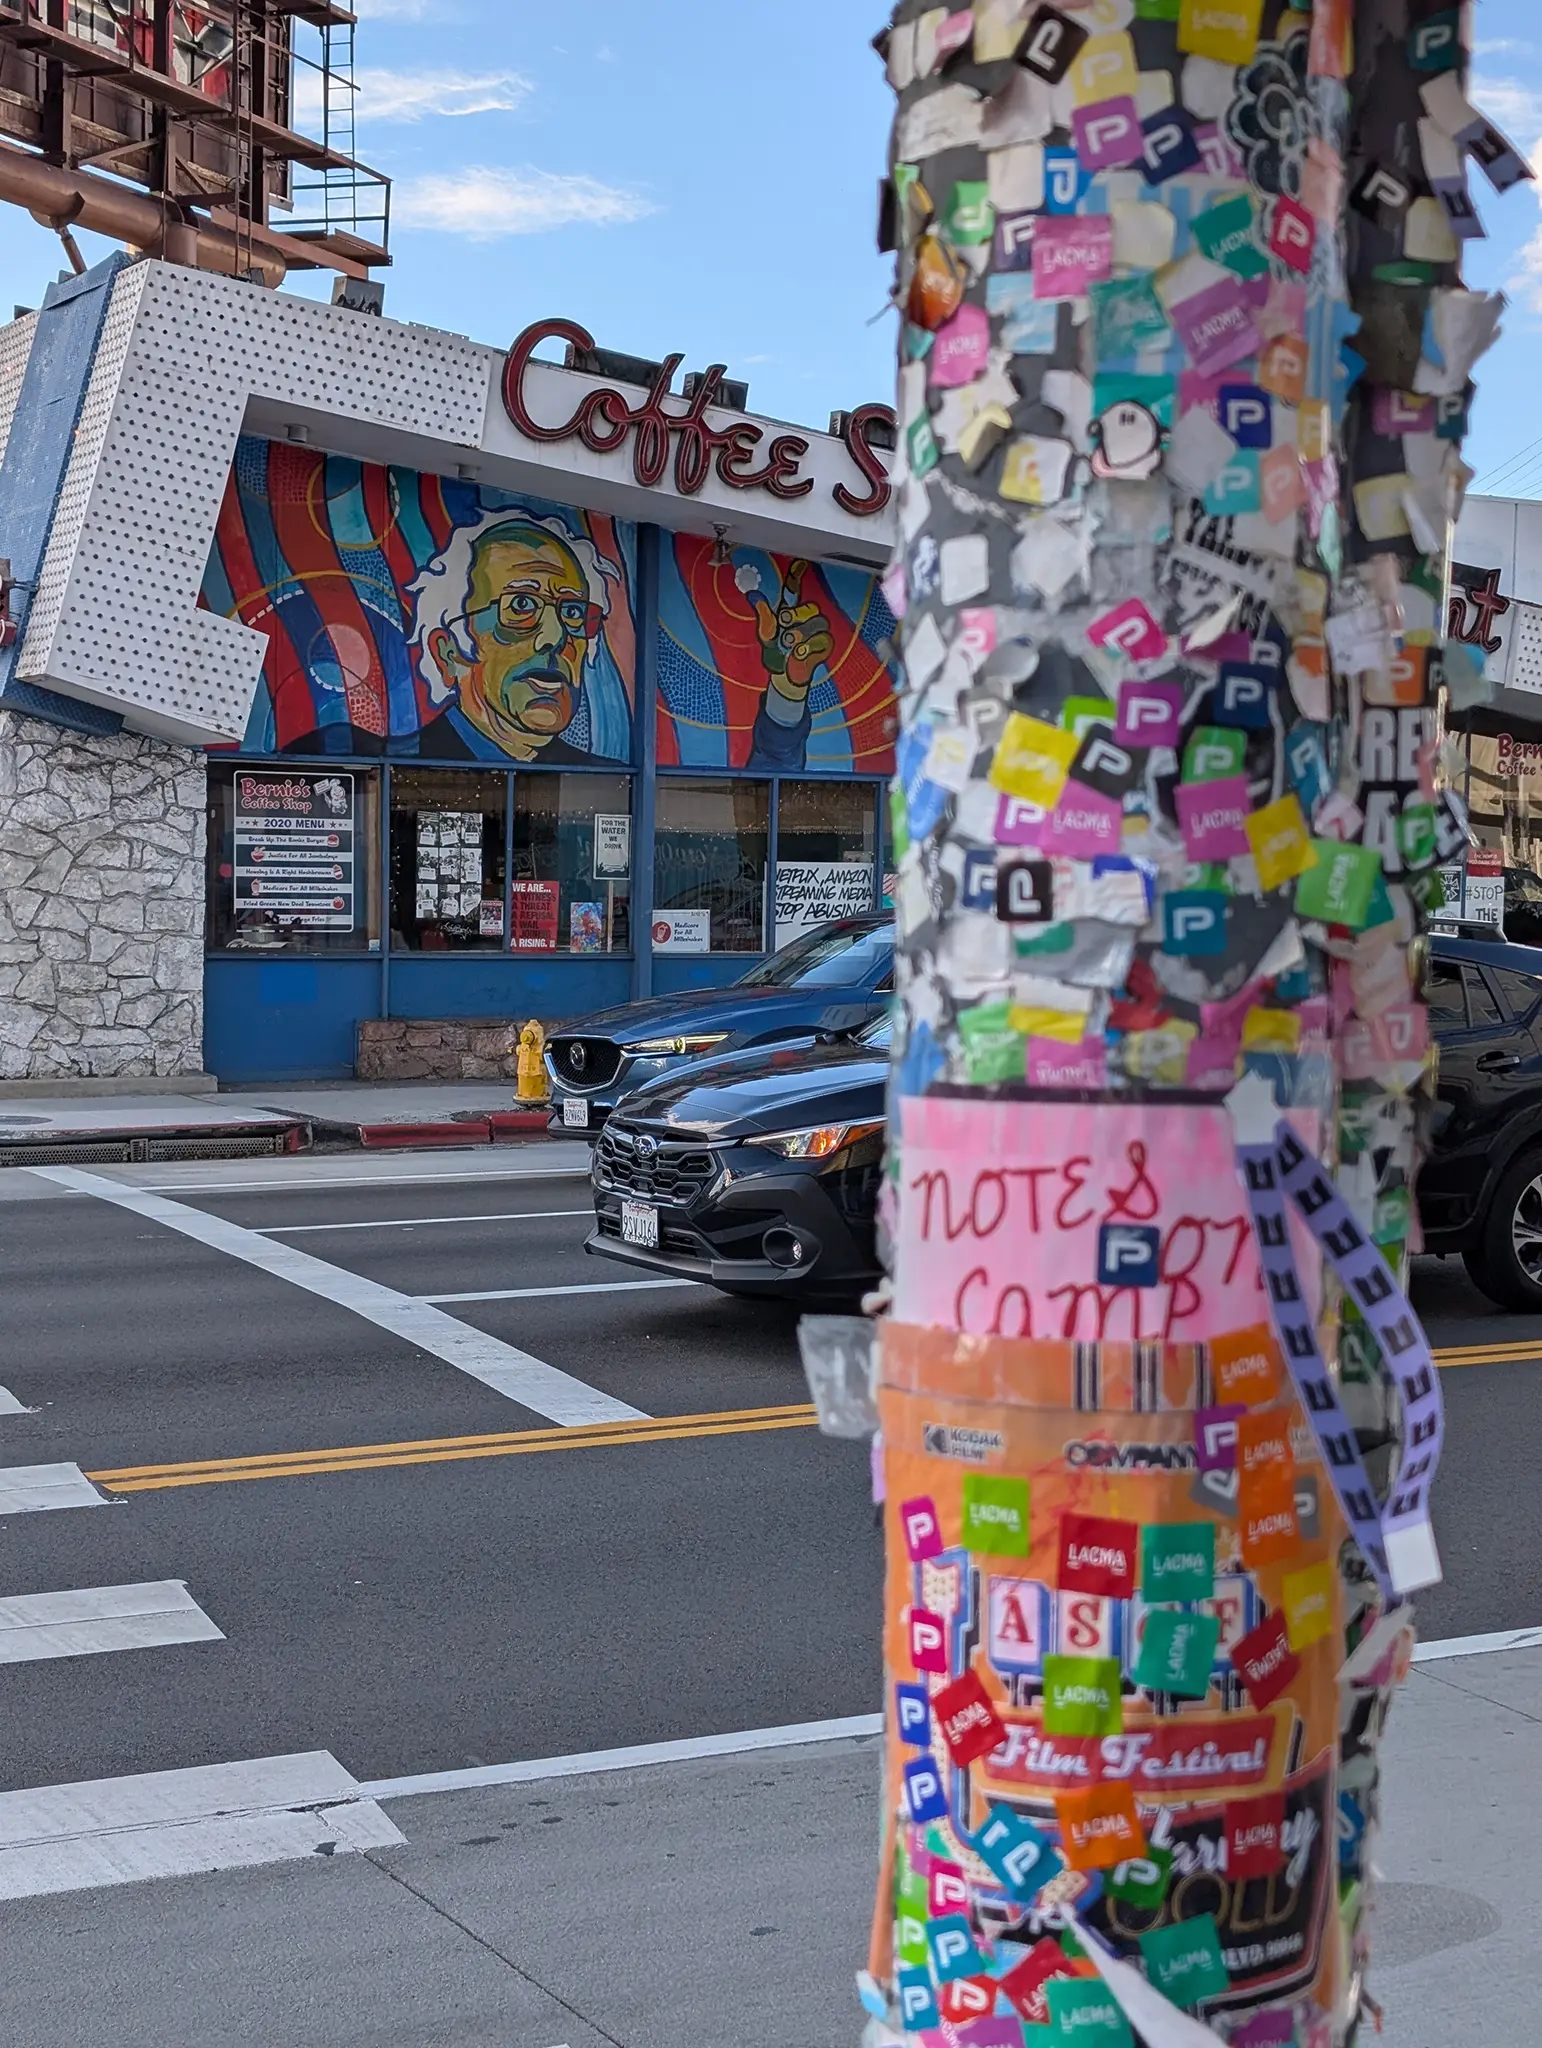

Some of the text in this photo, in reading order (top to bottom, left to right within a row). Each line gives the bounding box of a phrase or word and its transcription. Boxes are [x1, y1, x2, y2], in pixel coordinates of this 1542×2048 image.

[1084, 114, 1132, 152] P
[1144, 124, 1185, 167] P
[1224, 396, 1268, 430] P
[833, 403, 899, 516] S
[1126, 691, 1172, 731] P
[1224, 677, 1265, 713] P
[1081, 739, 1132, 777] P
[1193, 745, 1234, 777] P
[1497, 733, 1542, 758] Bern
[1497, 760, 1536, 776] Coffee
[241, 777, 310, 798] Bernie's
[241, 796, 312, 814] Coffee Shop
[264, 819, 325, 829] 2020 MENU
[1052, 806, 1112, 839] LACMA
[282, 869, 297, 877] Right
[512, 883, 552, 893] WE ARE...
[520, 893, 557, 902] WITNESS
[520, 902, 551, 911] THREAT
[838, 886, 872, 900] MEDIA
[1466, 884, 1503, 900] #STOP
[519, 920, 539, 929] WAIL
[1172, 906, 1216, 939] P
[1475, 907, 1498, 921] THE
[510, 938, 547, 948] A RISING.
[1106, 1235, 1148, 1271] P
[1221, 1353, 1270, 1388] LACMA
[950, 1426, 1002, 1446] KODAK
[1244, 1439, 1286, 1470] LACMA
[907, 1512, 934, 1548] P
[970, 1503, 1019, 1532] LACMA
[1248, 1512, 1294, 1543] LACMA
[1067, 1543, 1127, 1576] LACMA
[1152, 1553, 1207, 1578] LACMA
[912, 1621, 941, 1654] P
[1167, 1623, 1196, 1681] LACMA
[900, 1697, 925, 1730] P
[1053, 1685, 1110, 1710] LACMA
[944, 1701, 992, 1746] LACMA
[988, 1722, 1265, 1778] Film Festival
[909, 1772, 937, 1810] P
[1071, 1813, 1132, 1848] LACMA
[1234, 1822, 1277, 1856] LACMA
[1002, 1841, 1040, 1886] P
[935, 1872, 966, 1907] P
[935, 1930, 968, 1968] P
[1159, 1948, 1213, 1983] LACMA
[903, 1985, 930, 2021] P
[1060, 2003, 1119, 2035] LACMA
